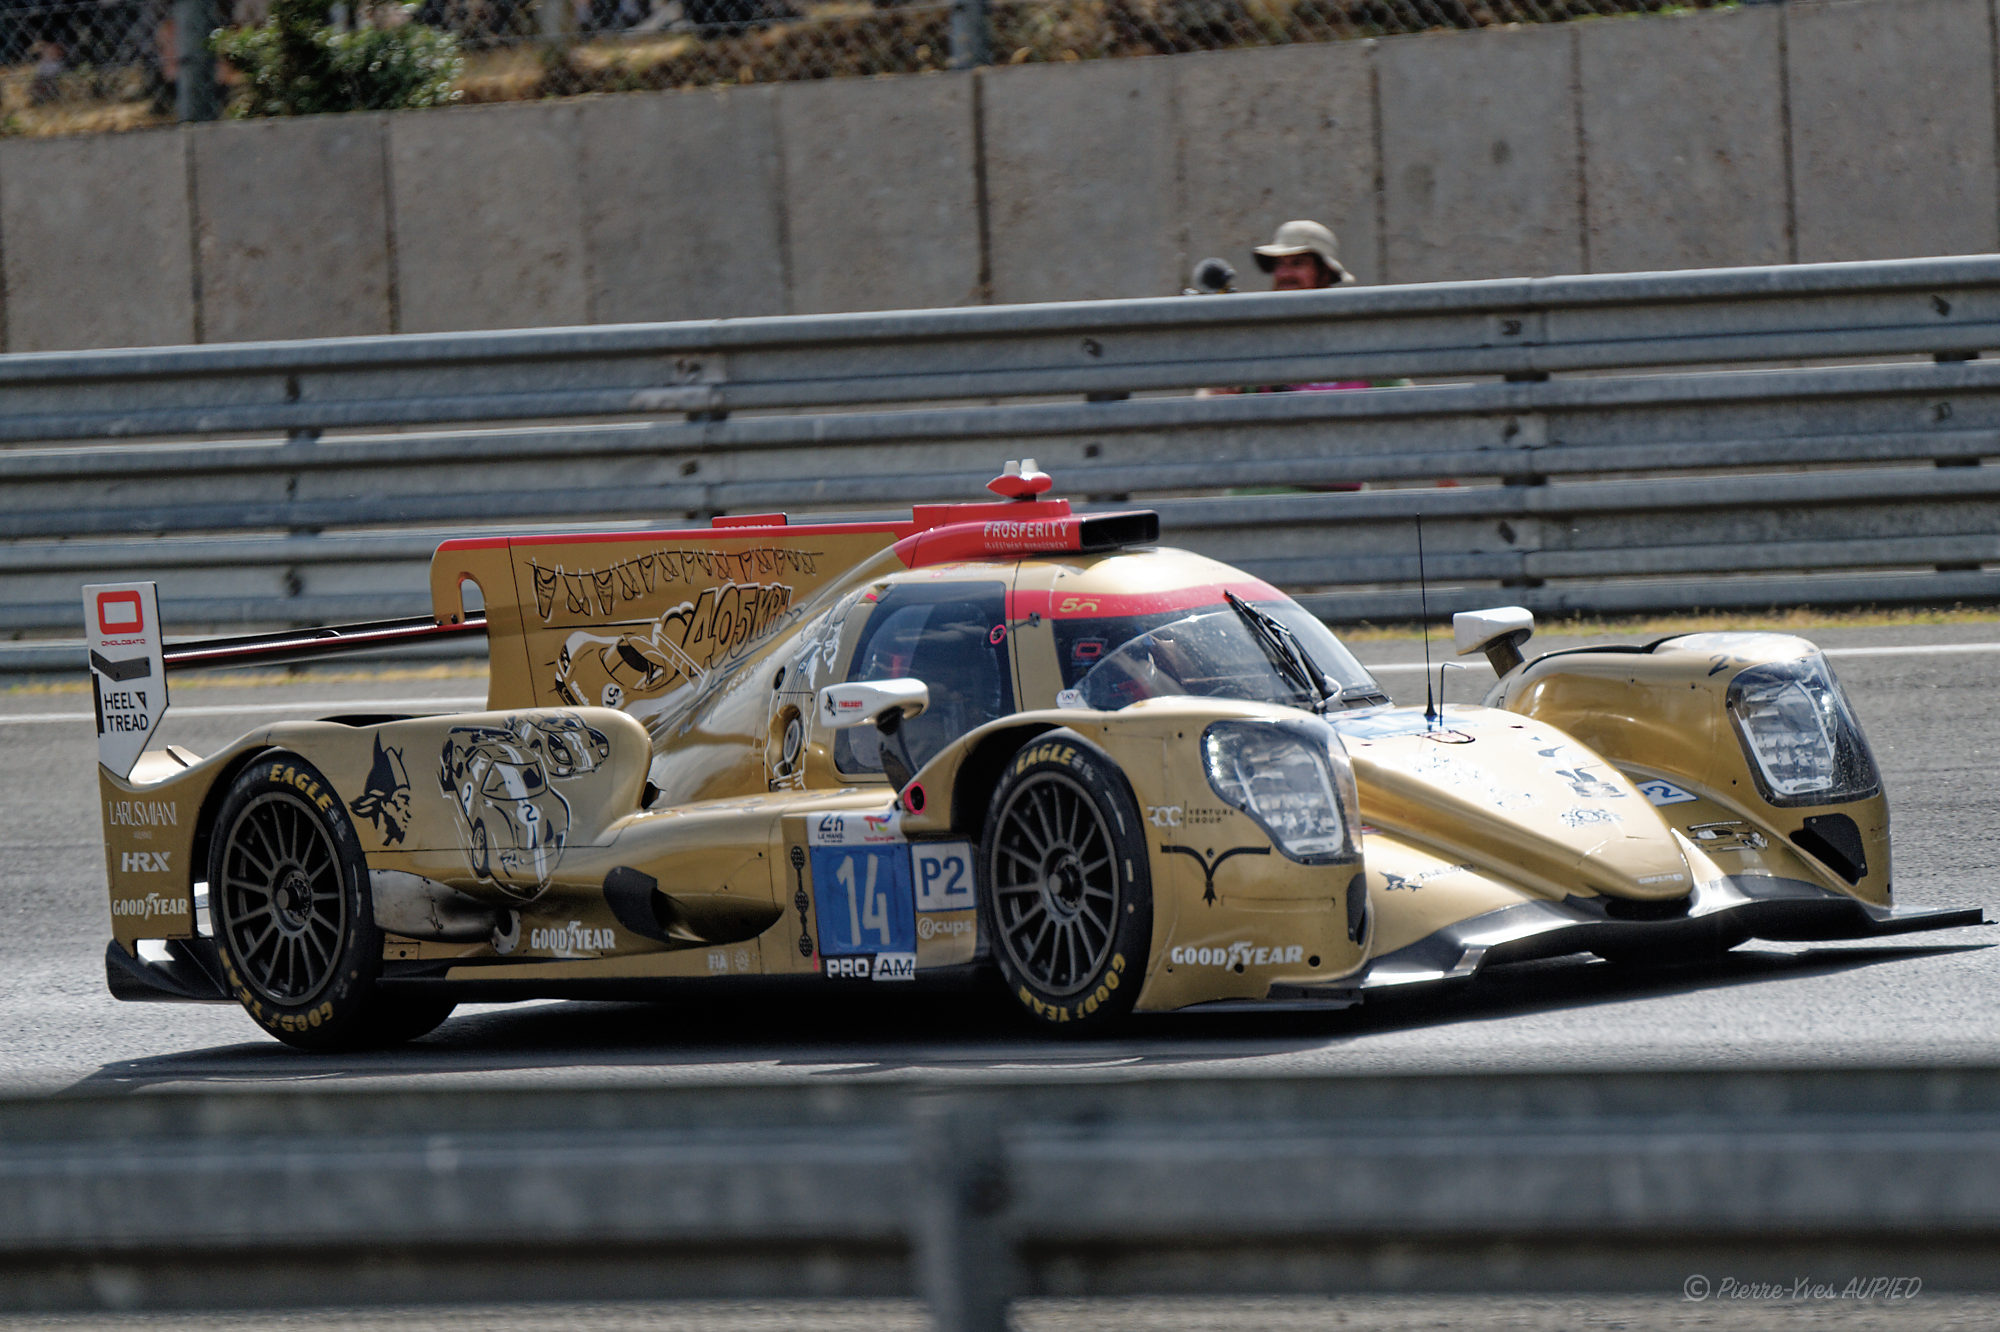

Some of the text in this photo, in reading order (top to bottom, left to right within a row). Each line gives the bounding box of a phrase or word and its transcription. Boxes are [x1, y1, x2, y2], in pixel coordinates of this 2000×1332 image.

[984, 521, 1069, 539] PROSPERITY
[101, 638, 146, 647] OMOLOGATO
[104, 692, 136, 711] HEEL
[106, 712, 149, 733] TREAD
[1016, 743, 1077, 776] EAGLE
[268, 763, 334, 814] EAGLE
[523, 804, 538, 822] 2
[121, 851, 171, 873] HRX
[919, 856, 967, 897] P2
[112, 892, 189, 921] GOODYEAR
[836, 853, 890, 947] 14
[531, 920, 616, 956] GOODYEAR
[1171, 940, 1304, 972] GOODYEAR
[826, 959, 914, 980] PRO AM
